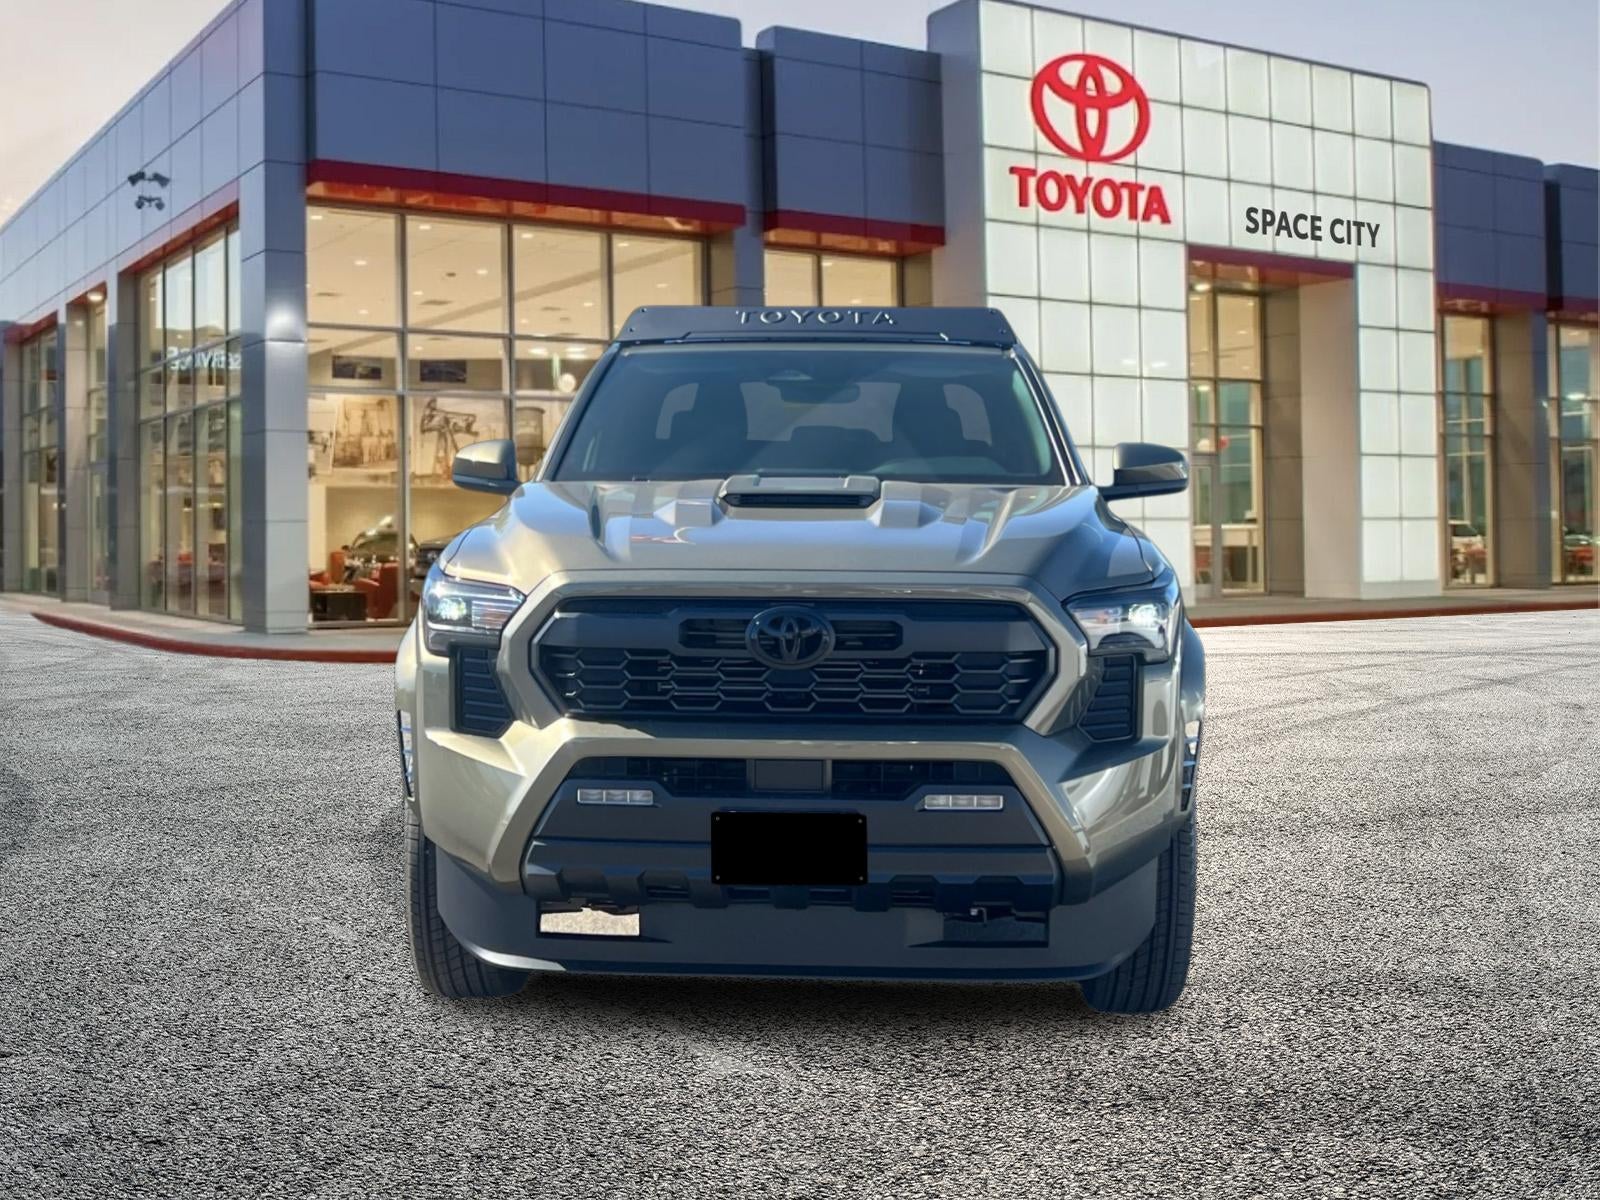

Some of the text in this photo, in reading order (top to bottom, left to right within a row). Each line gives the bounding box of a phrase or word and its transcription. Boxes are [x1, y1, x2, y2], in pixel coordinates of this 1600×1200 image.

[1009, 166, 1171, 224] TOYOTA
[1245, 206, 1381, 248] SPACE CITY
[736, 309, 897, 325] TOYOTA
